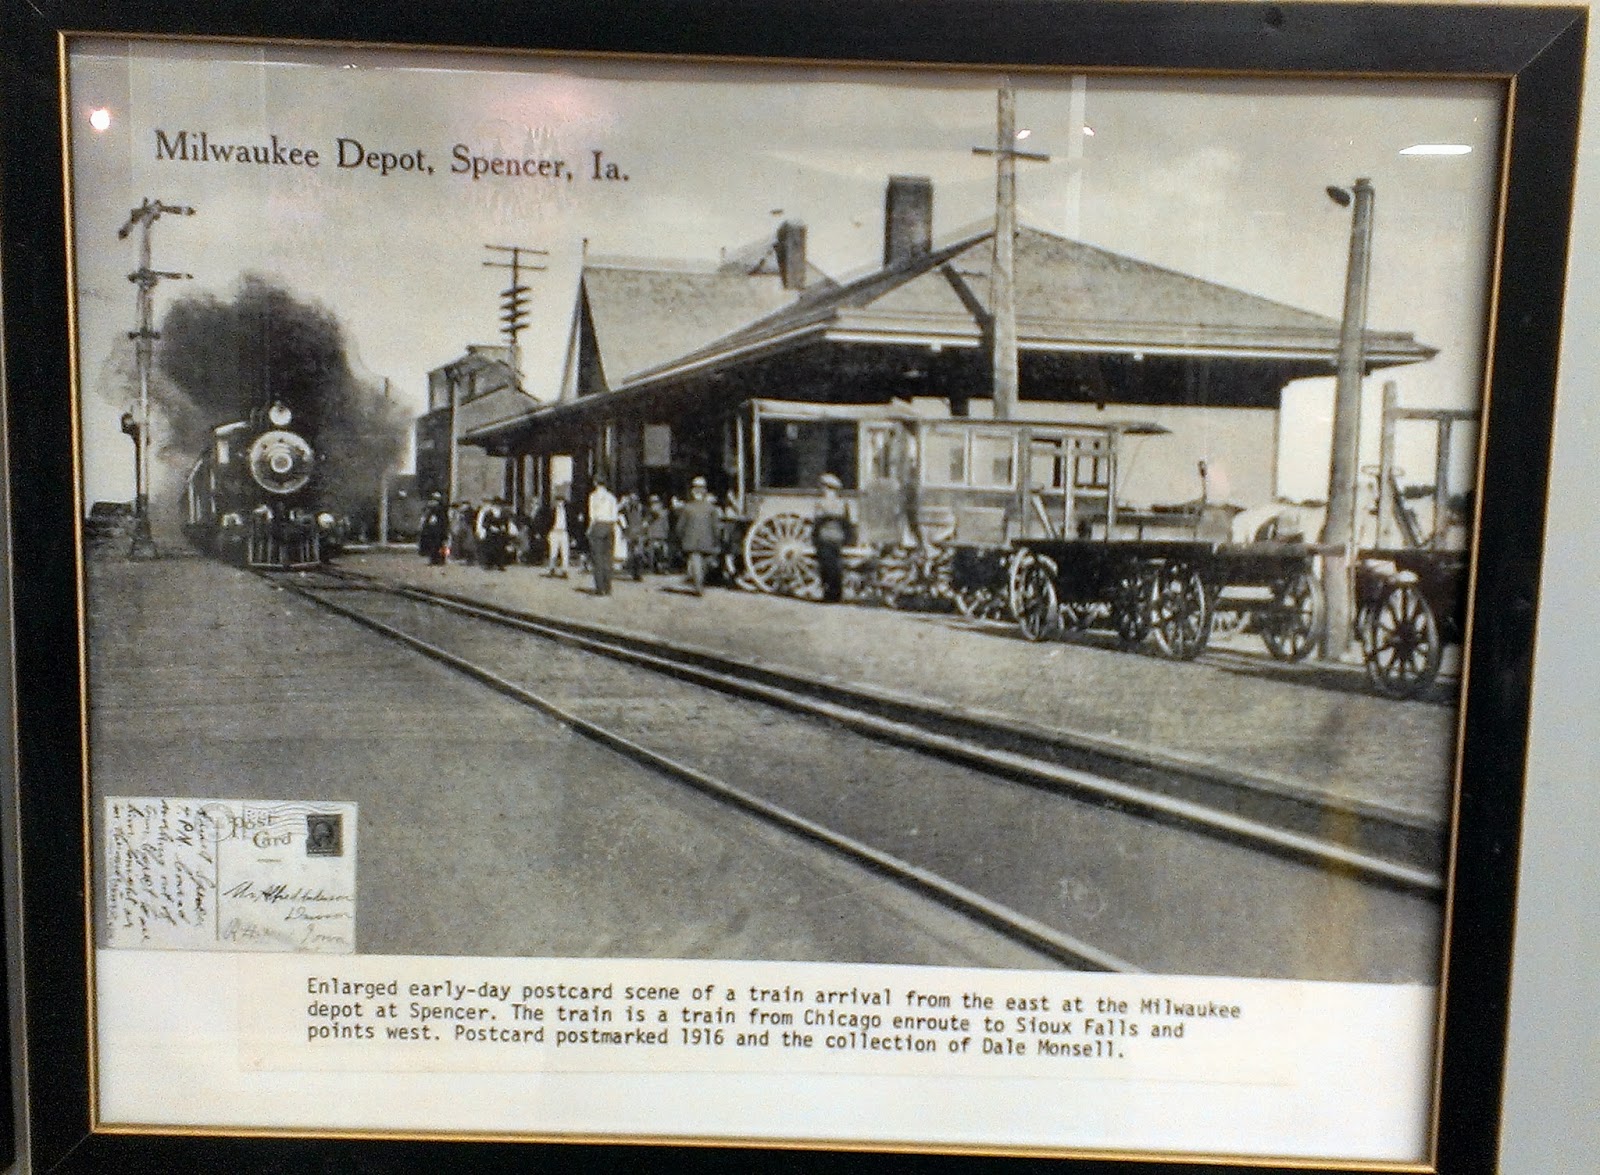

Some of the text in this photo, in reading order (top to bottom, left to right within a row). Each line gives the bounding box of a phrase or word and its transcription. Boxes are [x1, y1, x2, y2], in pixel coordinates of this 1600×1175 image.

[155, 129, 630, 183] Milwaukee Depot, Spencer, Ia.
[307, 977, 1242, 1018] Enlarged early-day postcard scene of a train arrival from the east at the Milwaukee
[307, 1000, 1185, 1039] depot at Spencer. The train is a train from Chicago enroute to Sioux Falls and
[307, 1023, 1125, 1059] points west. Postcard postmarked 1916 and the collection of Dale Monsell.
